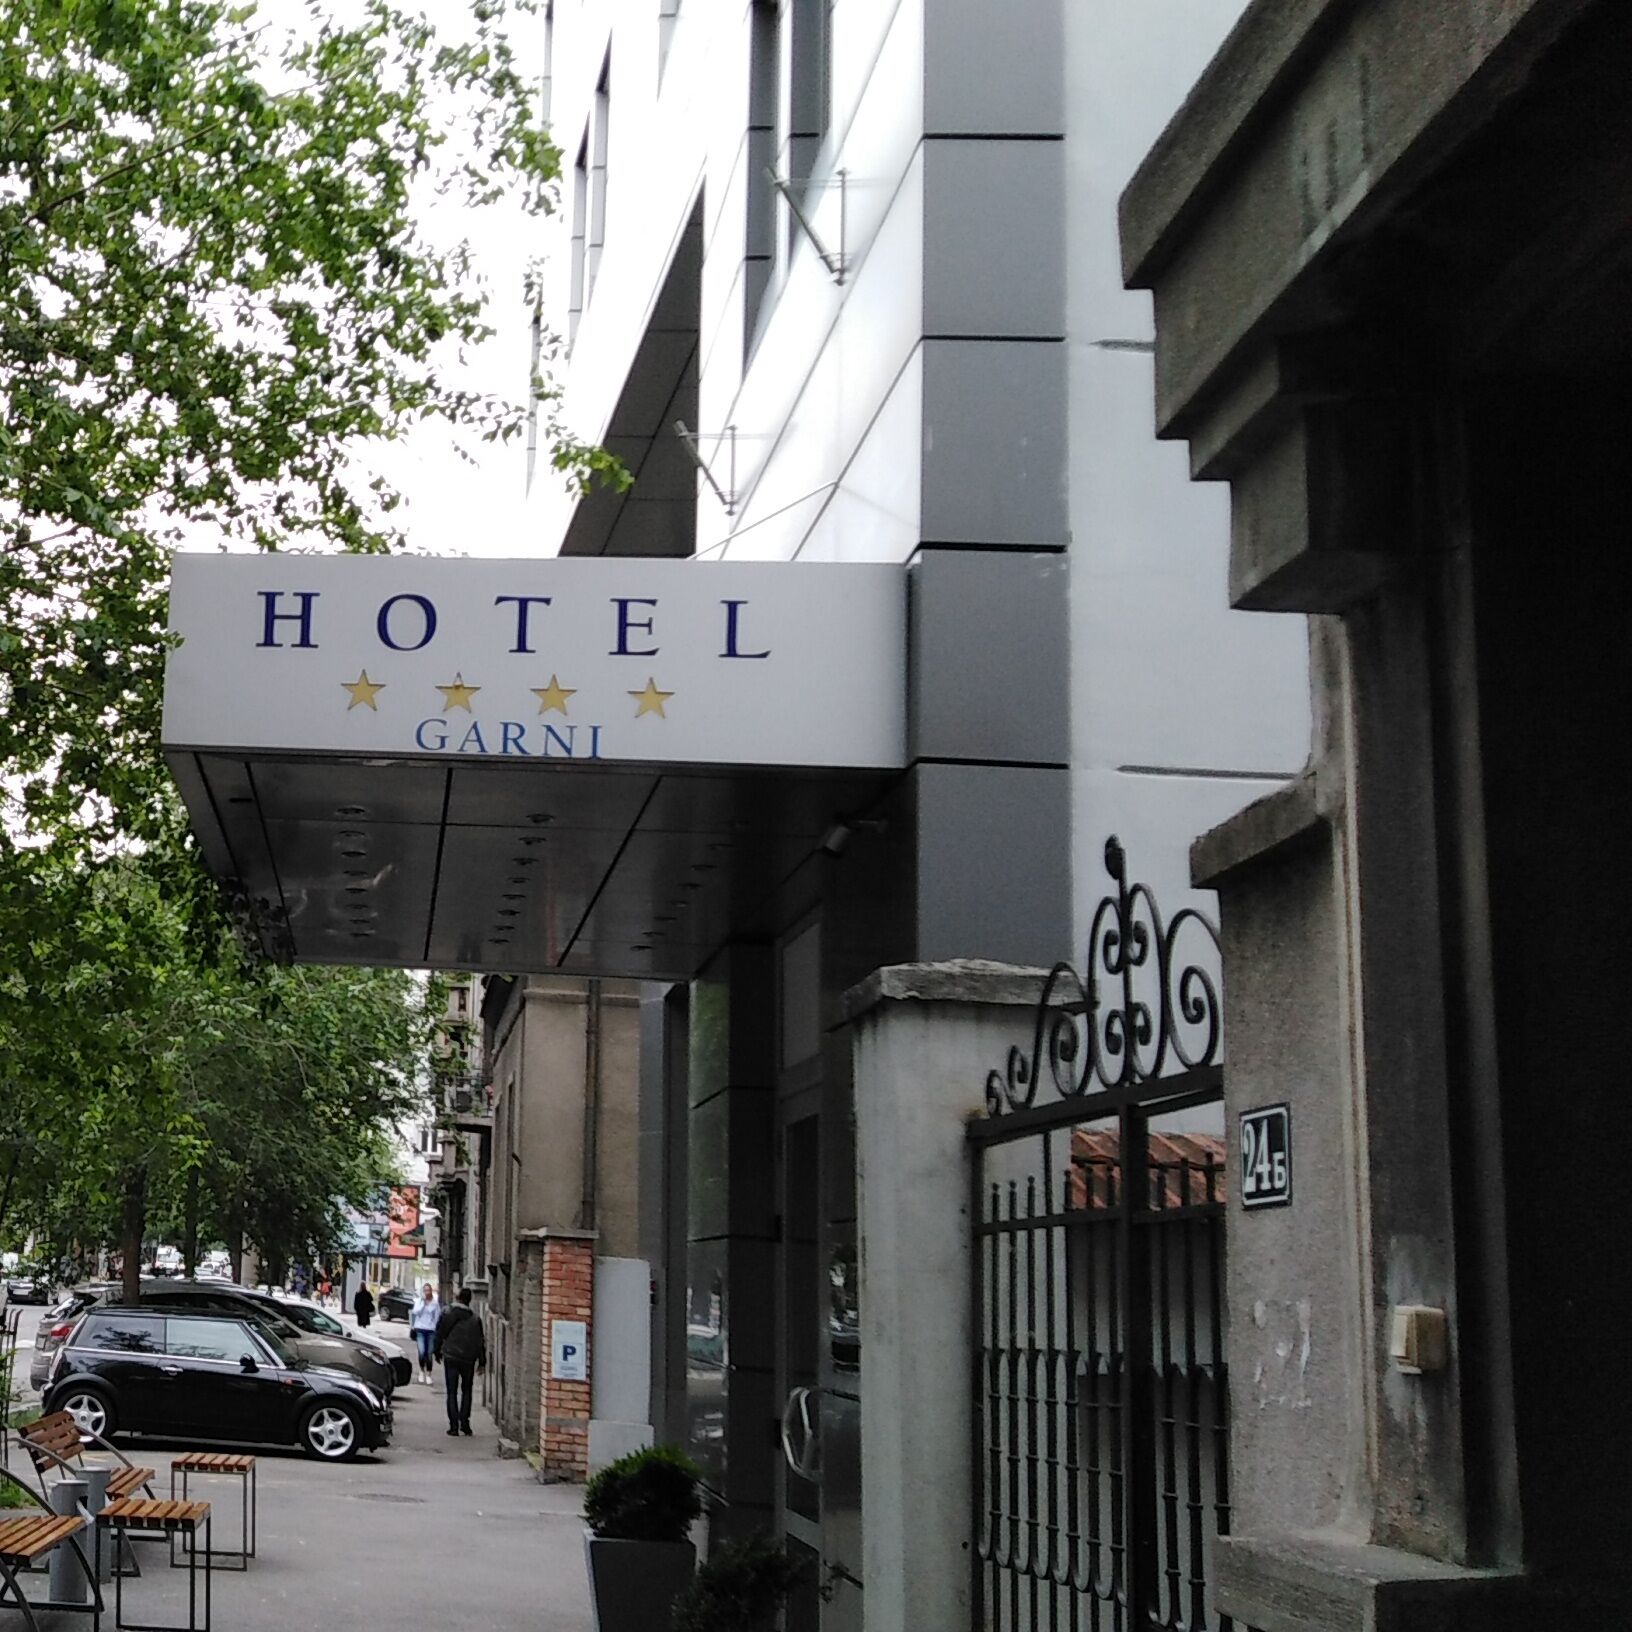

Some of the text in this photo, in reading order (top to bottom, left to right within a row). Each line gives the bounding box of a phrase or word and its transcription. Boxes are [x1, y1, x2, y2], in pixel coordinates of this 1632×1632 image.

[255, 590, 772, 659] HOTEL
[415, 718, 603, 761] GARNI
[562, 1344, 577, 1362] P
